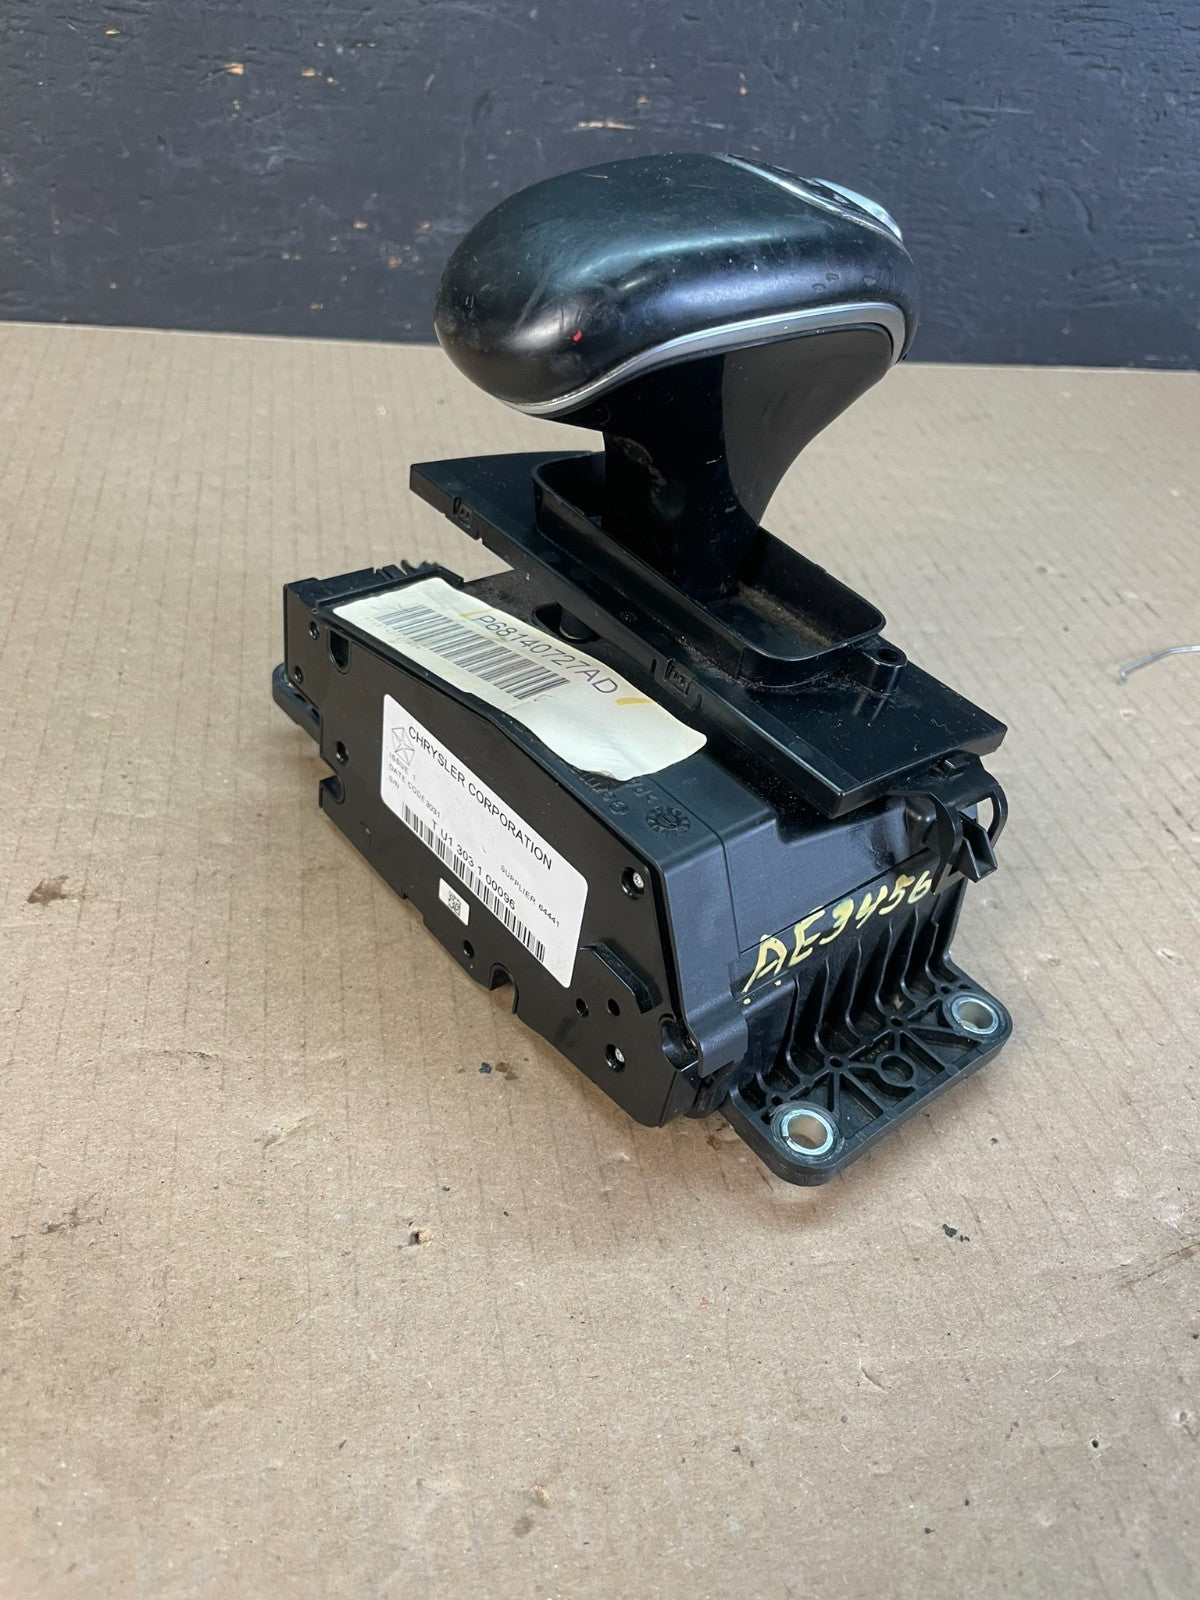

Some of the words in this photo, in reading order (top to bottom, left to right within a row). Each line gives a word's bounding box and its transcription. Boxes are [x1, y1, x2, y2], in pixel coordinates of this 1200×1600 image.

[472, 613, 619, 695] P68140727AD
[388, 763, 407, 786] DATE
[407, 781, 426, 804] CODE
[389, 753, 410, 775] ISSUE
[408, 726, 466, 789] CHRYSLER
[468, 782, 553, 871] CORPORATION
[441, 828, 454, 847] U1
[456, 844, 475, 868] 303
[485, 874, 516, 911] 00096
[500, 864, 537, 905] SUPPLIER
